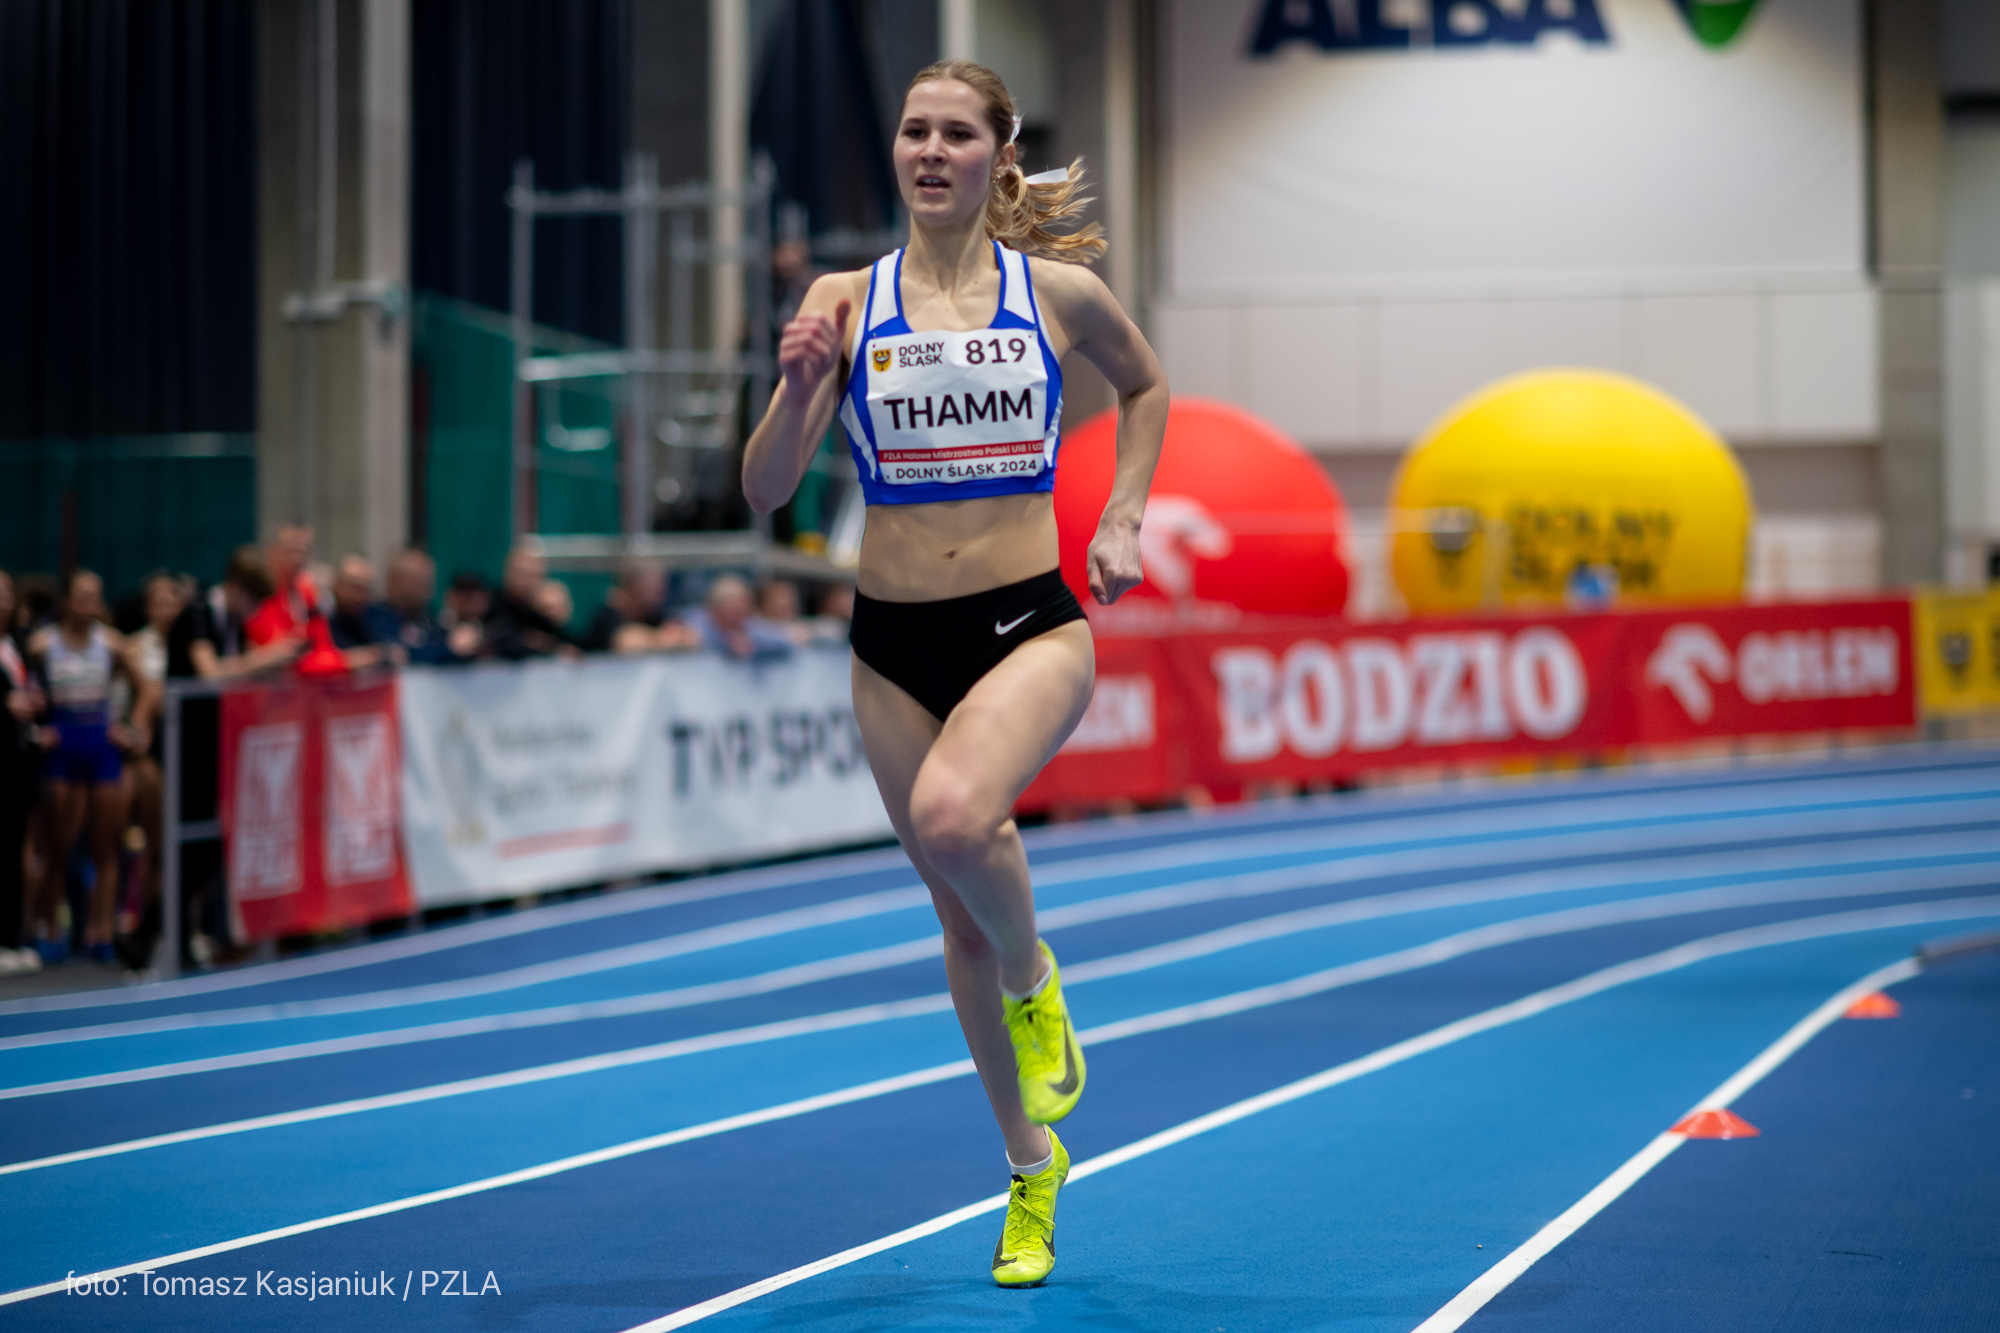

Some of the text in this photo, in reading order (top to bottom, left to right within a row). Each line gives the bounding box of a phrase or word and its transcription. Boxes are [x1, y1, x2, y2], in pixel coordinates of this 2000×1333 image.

[898, 341, 945, 357] DOLNY
[965, 337, 1027, 365] 819
[883, 388, 1033, 430] THAMM
[883, 452, 901, 460] PZLA
[902, 452, 931, 460] Halowe
[933, 446, 984, 459] Mistrzostwa
[985, 446, 1010, 455] Polski
[1011, 443, 1026, 453] U18
[1032, 442, 1044, 451] U2
[896, 459, 1037, 479] DOLNY ŚLĄSK 2024
[1736, 625, 1899, 705] ORLEN
[1211, 625, 1589, 764] BODZIO
[768, 706, 867, 788] SPO
